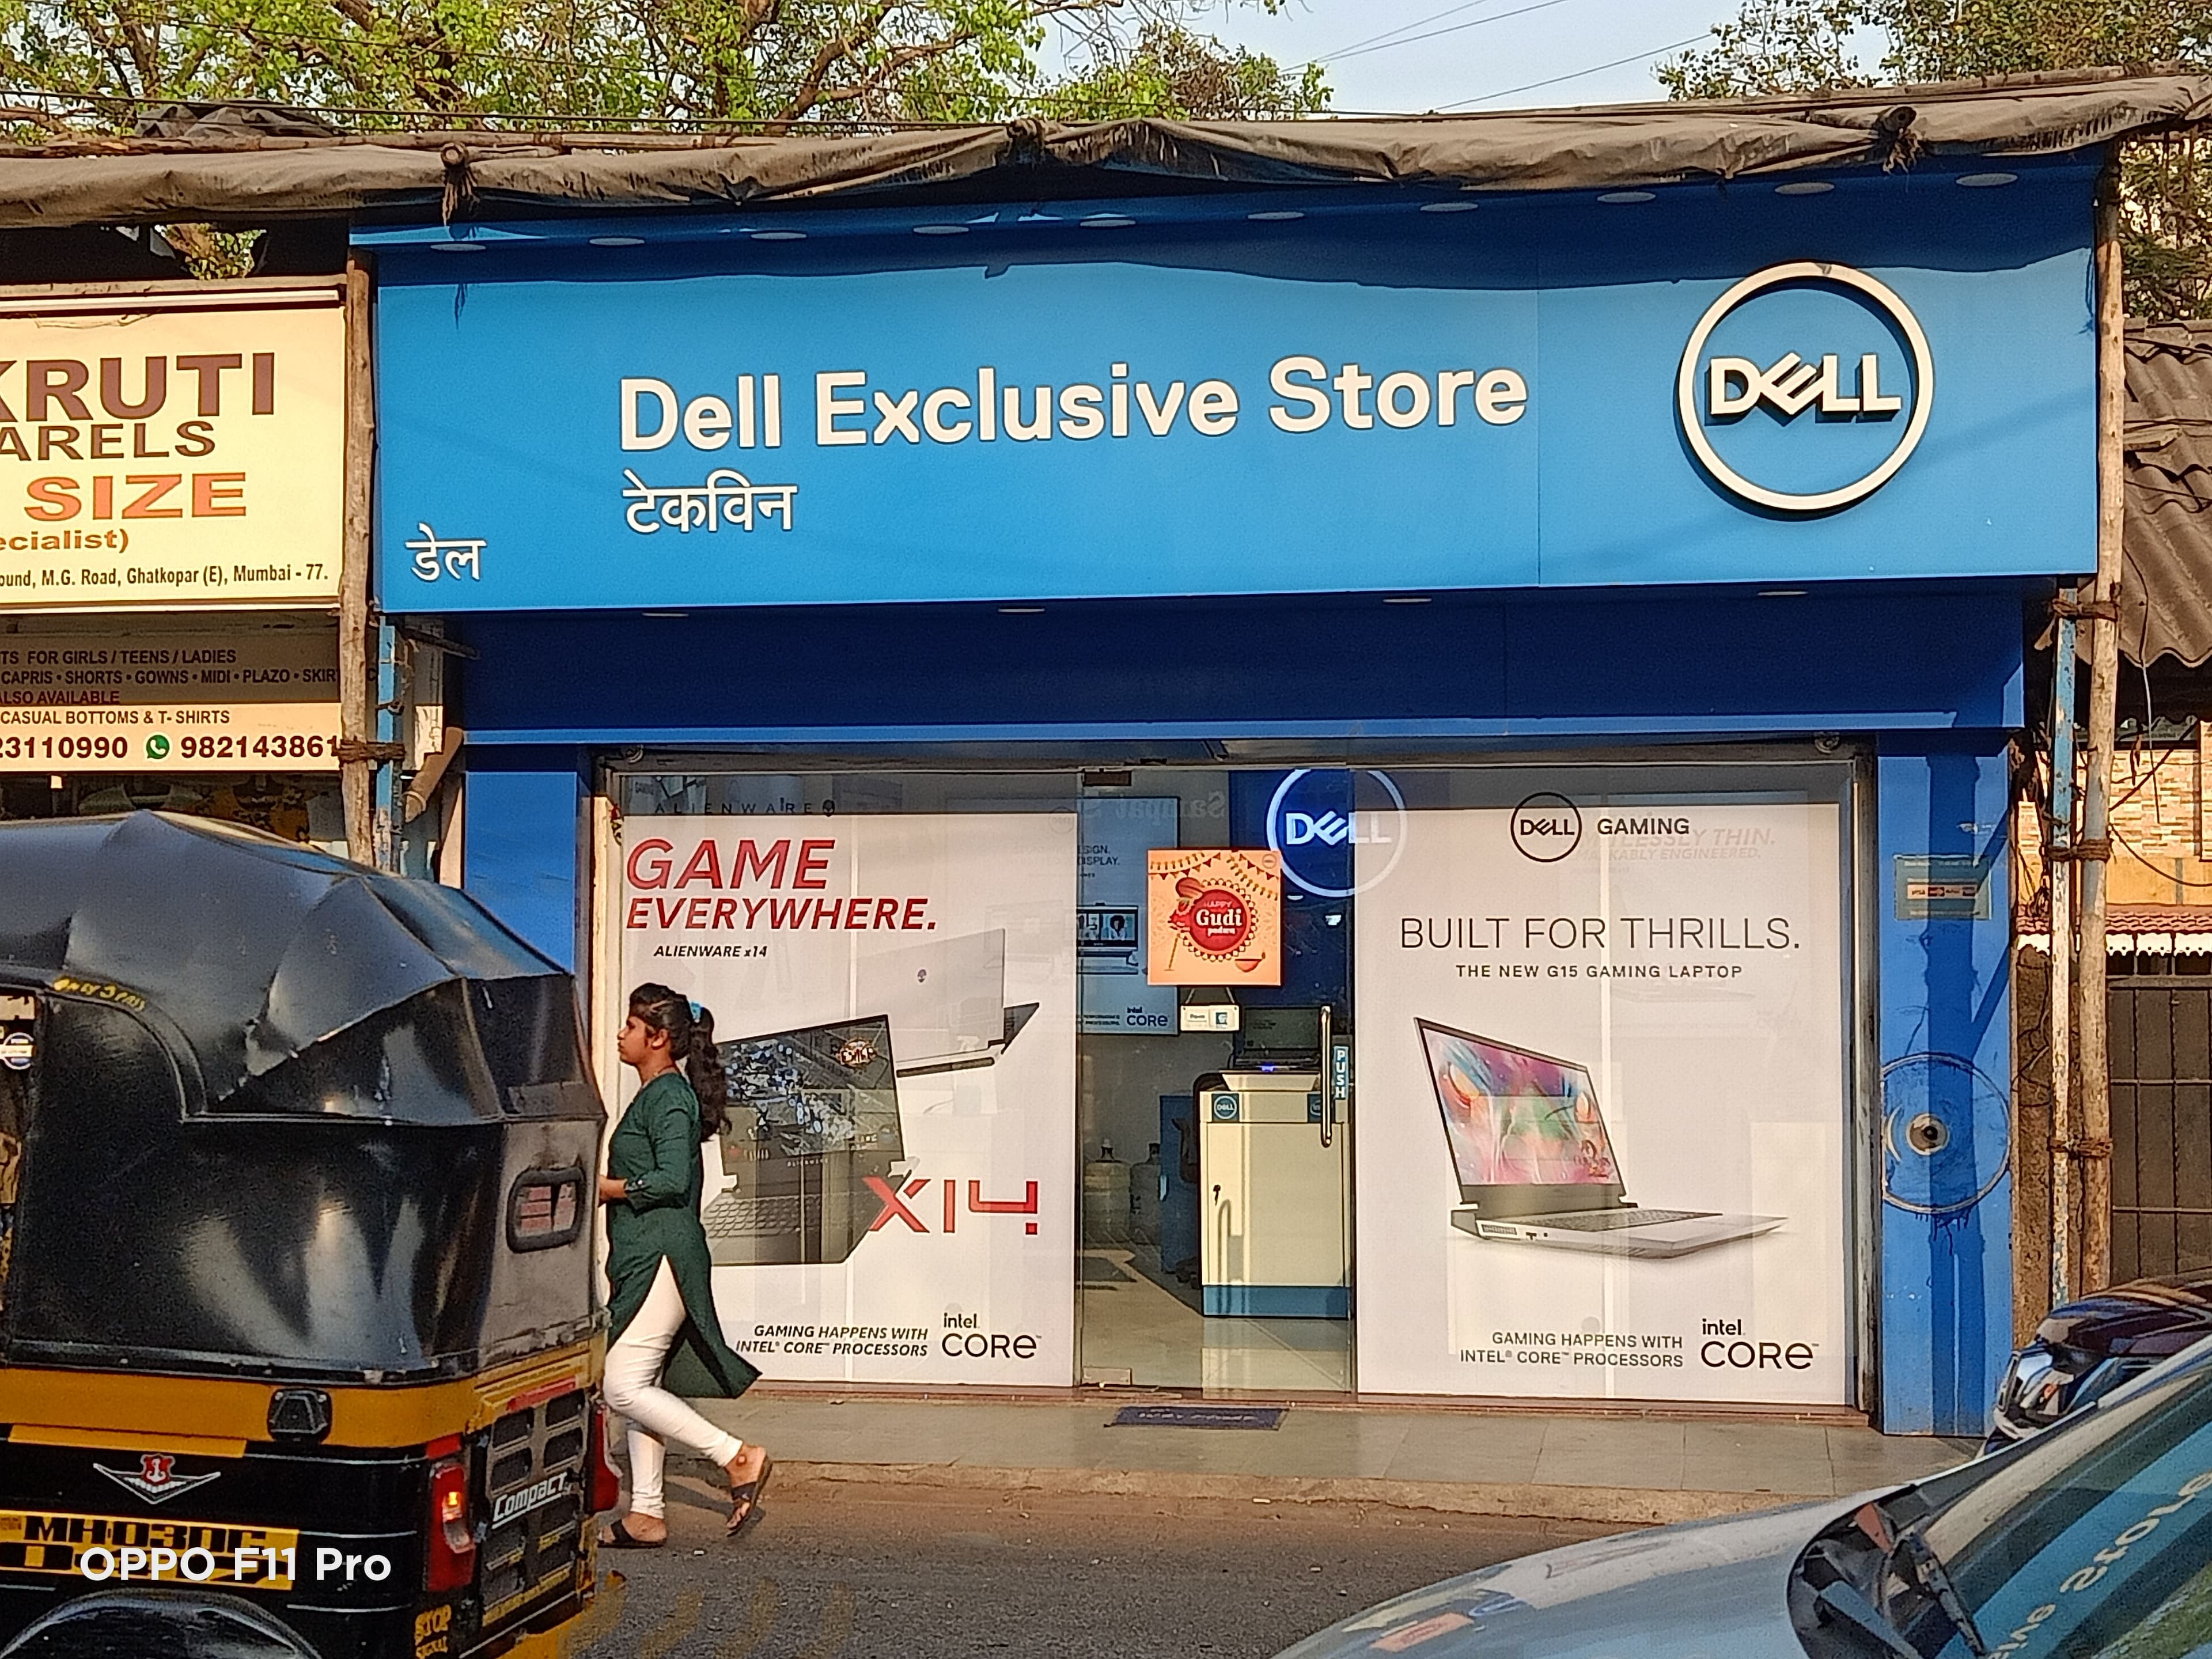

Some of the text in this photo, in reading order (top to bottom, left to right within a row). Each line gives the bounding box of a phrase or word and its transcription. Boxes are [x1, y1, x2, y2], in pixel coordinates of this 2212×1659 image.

[1709, 352, 1902, 416] DELL
[620, 355, 1528, 452] Dell Exclusive Store
[24, 472, 247, 521] SIZE
[622, 469, 798, 533] टेकविन
[405, 523, 487, 581] डेल
[41, 569, 75, 586] M.G.
[81, 568, 121, 588] Road,
[127, 566, 199, 587] Ghatkopar
[233, 564, 291, 582] Mumbai
[306, 564, 329, 581] 77.
[28, 650, 58, 664] FOR
[63, 650, 108, 664] GIRLS
[120, 650, 169, 664] TEENS
[182, 649, 237, 664] LADIES
[2, 671, 52, 684] CAPRIS
[65, 670, 122, 684] SHORTS
[135, 670, 189, 684] GOWNS
[201, 670, 231, 684] MIDI
[243, 669, 290, 683] PLAZO
[0, 690, 120, 704] LSO AVAILABLE
[1, 711, 62, 724] CASUAL
[66, 711, 138, 724] BOTTOMS
[143, 711, 154, 724] &
[175, 710, 230, 724] SHIRTS
[0, 737, 128, 758] 3110990
[1286, 811, 1392, 846] DELL
[1520, 817, 1690, 836] DELL GAMING
[626, 838, 835, 890] GAME
[626, 897, 937, 930] EVERYWHERE.
[1196, 908, 1243, 927] Gudi
[1400, 917, 1801, 950] BUILT FOR THRILLS.
[653, 945, 742, 958] ALIENWARE
[1456, 964, 1743, 979] THE NEW G15 GAMING LAPTOP
[1335, 1050, 1346, 1099] PUSH
[943, 1312, 978, 1329] intel
[1701, 1318, 1742, 1336] intel
[754, 1324, 929, 1340] GAMING HAPPENS WITH
[1491, 1332, 1683, 1349] GAMING HAPPENS WITH
[832, 1342, 929, 1357] PROCESSORS
[1573, 1352, 1684, 1368] PROCESSORS
